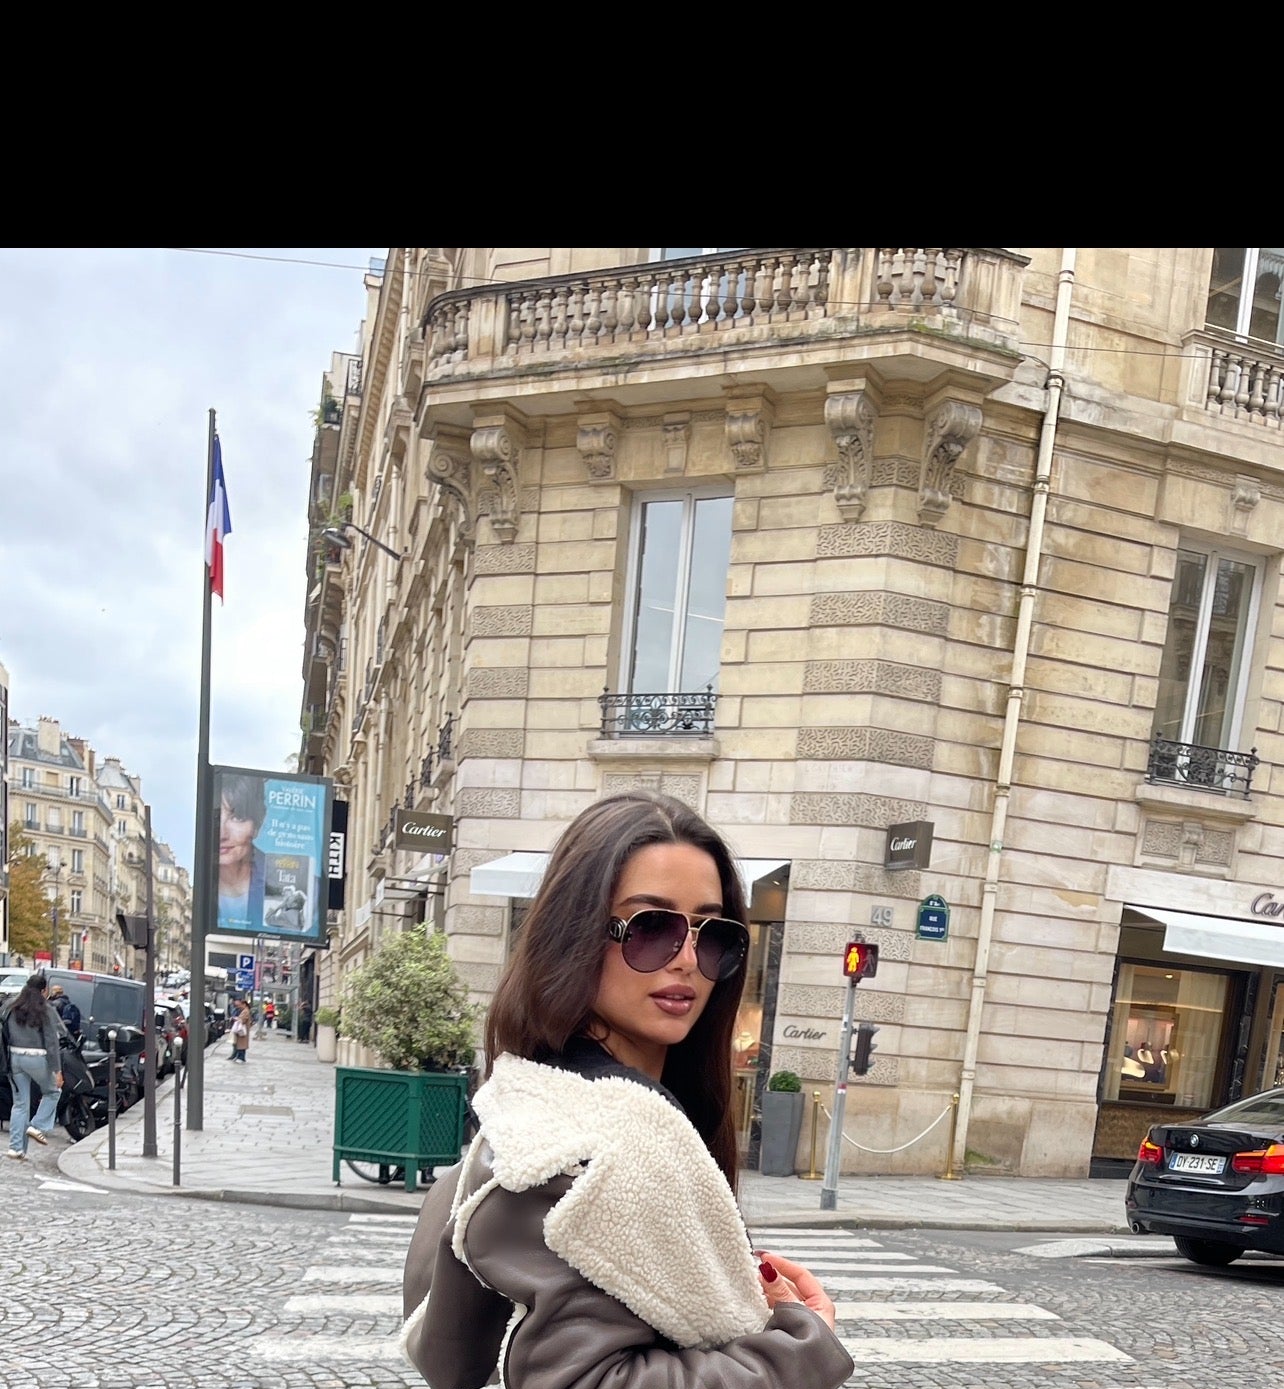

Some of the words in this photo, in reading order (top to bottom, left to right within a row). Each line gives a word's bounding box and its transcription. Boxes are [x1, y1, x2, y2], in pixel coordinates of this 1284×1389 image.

[269, 790, 316, 809] PERRIN
[402, 821, 447, 838] Cartier
[890, 837, 917, 851] Cartier
[329, 835, 342, 876] KITH
[276, 869, 297, 884] Tata
[872, 907, 892, 927] 49
[243, 957, 251, 967] P
[783, 1025, 827, 1040] Cartier
[1177, 1156, 1218, 1171] DY-231-SE
